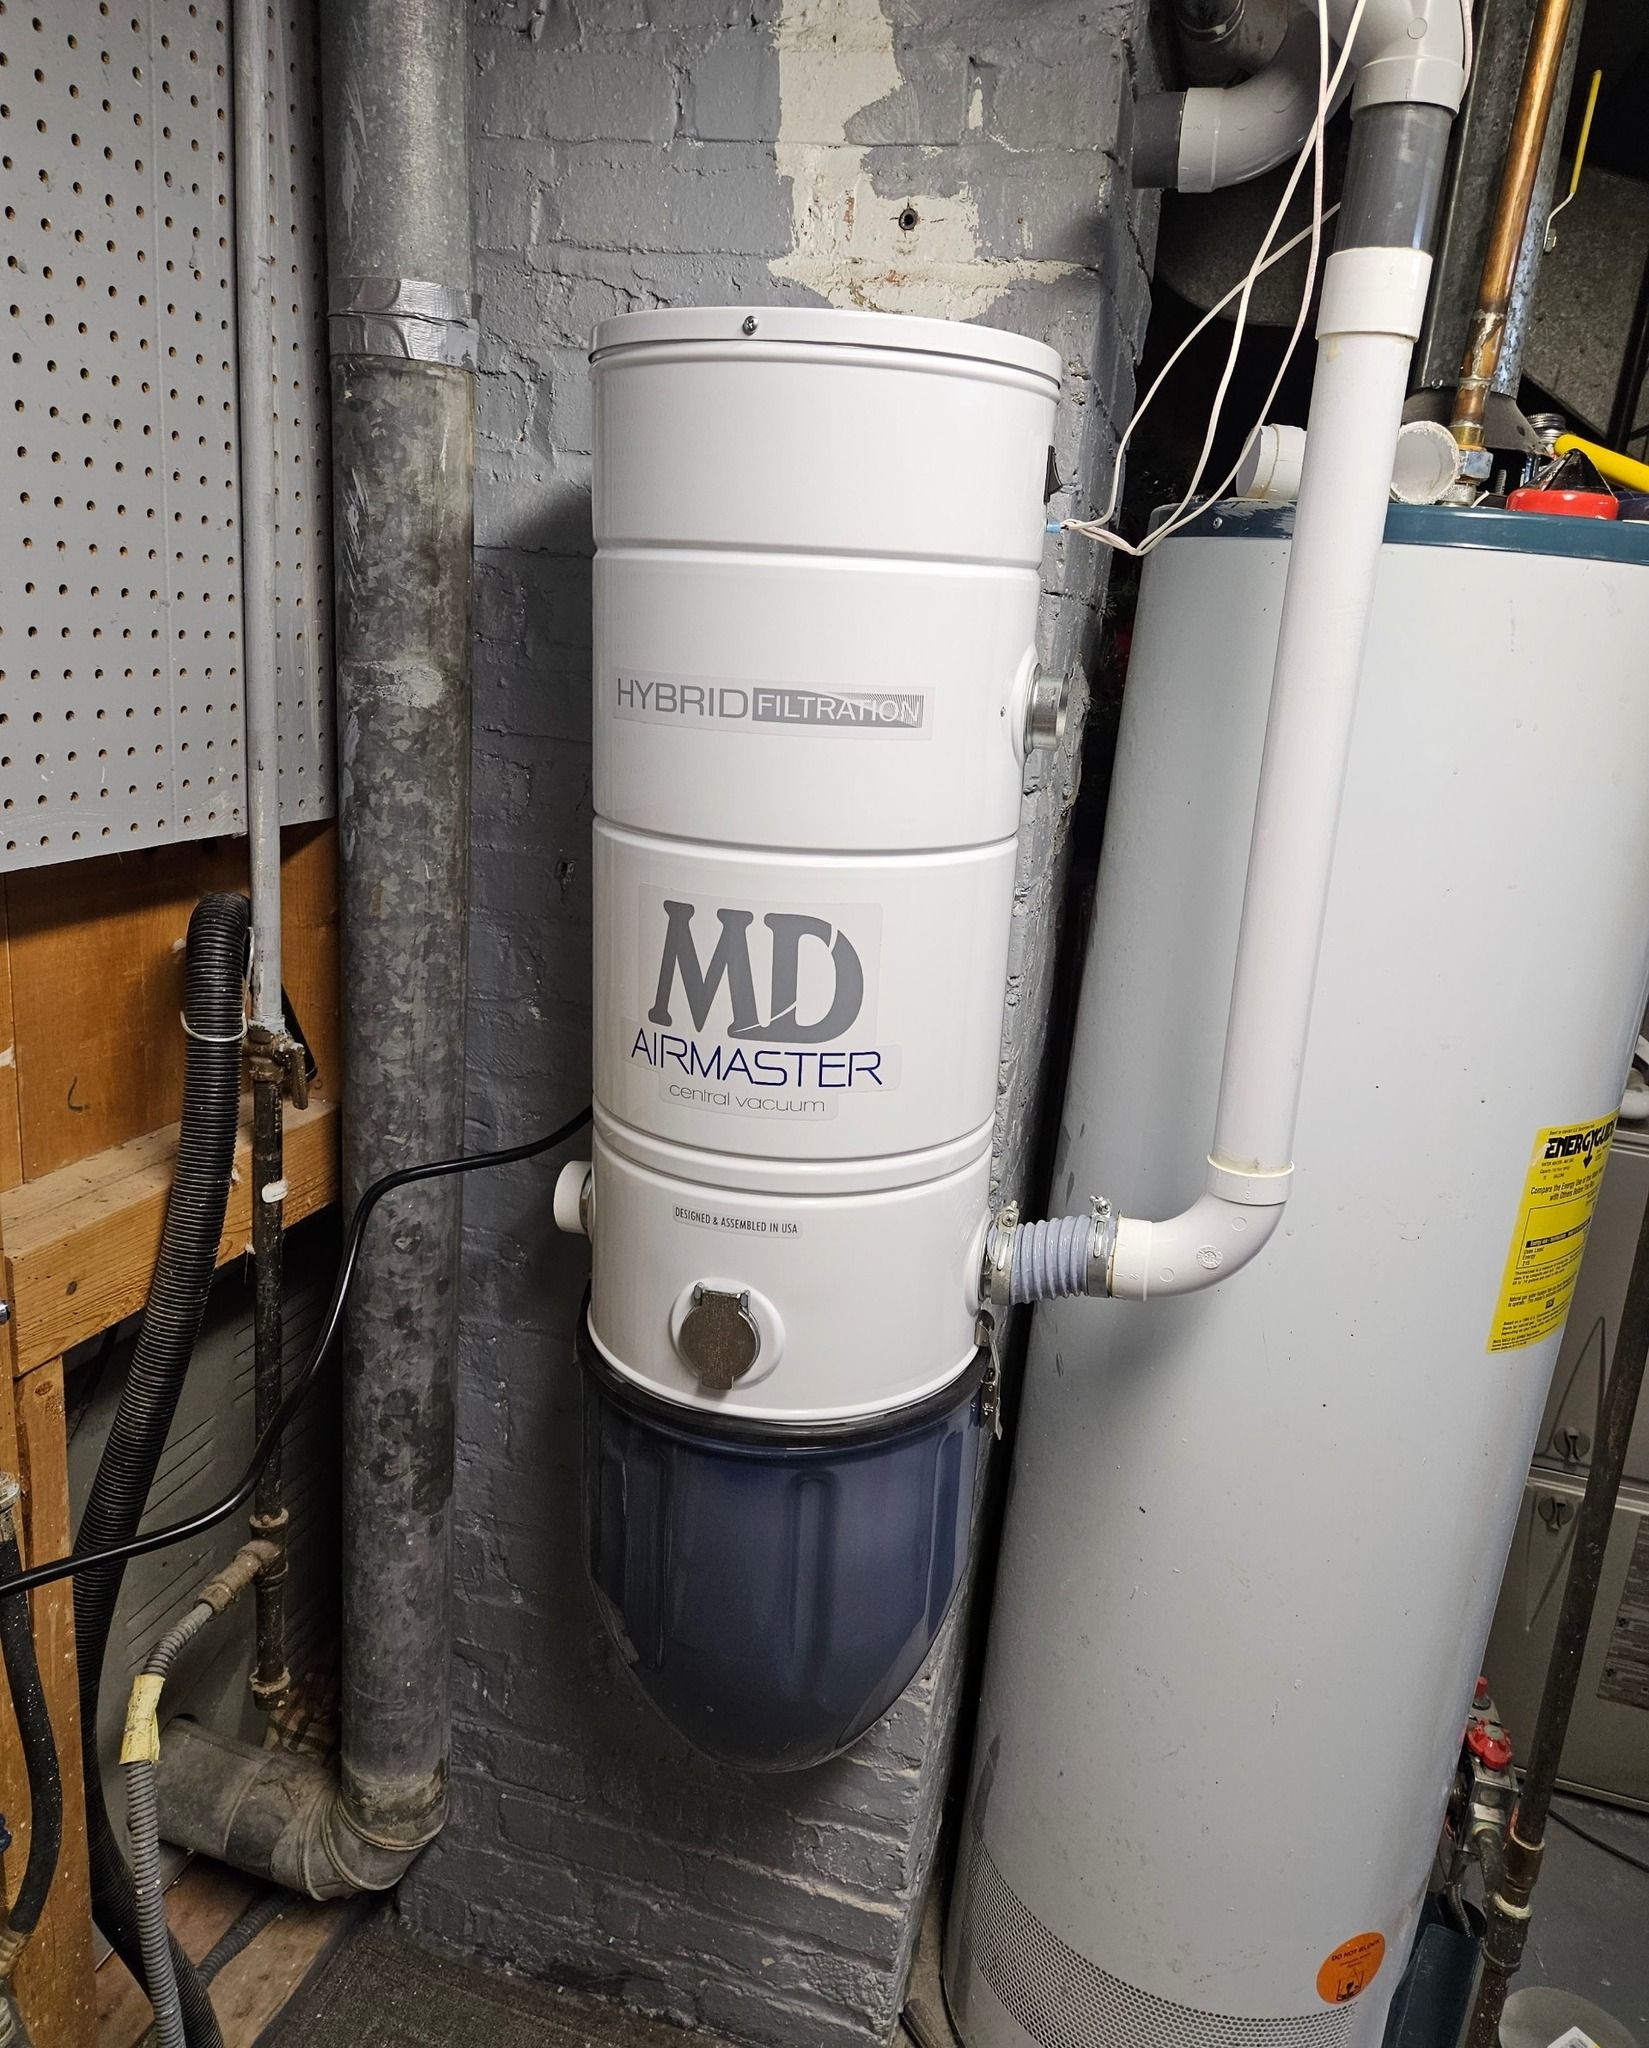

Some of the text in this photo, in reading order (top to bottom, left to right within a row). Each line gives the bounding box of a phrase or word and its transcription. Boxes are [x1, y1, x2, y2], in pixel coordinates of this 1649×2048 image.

[617, 677, 921, 724] HYBRID FILTRATION
[647, 899, 864, 1044] MD
[631, 1027, 883, 1088] AIRMASTER
[669, 1082, 825, 1113] central vacuum
[675, 1207, 798, 1234] DESIGNED & ASSEMBLED IN USA
